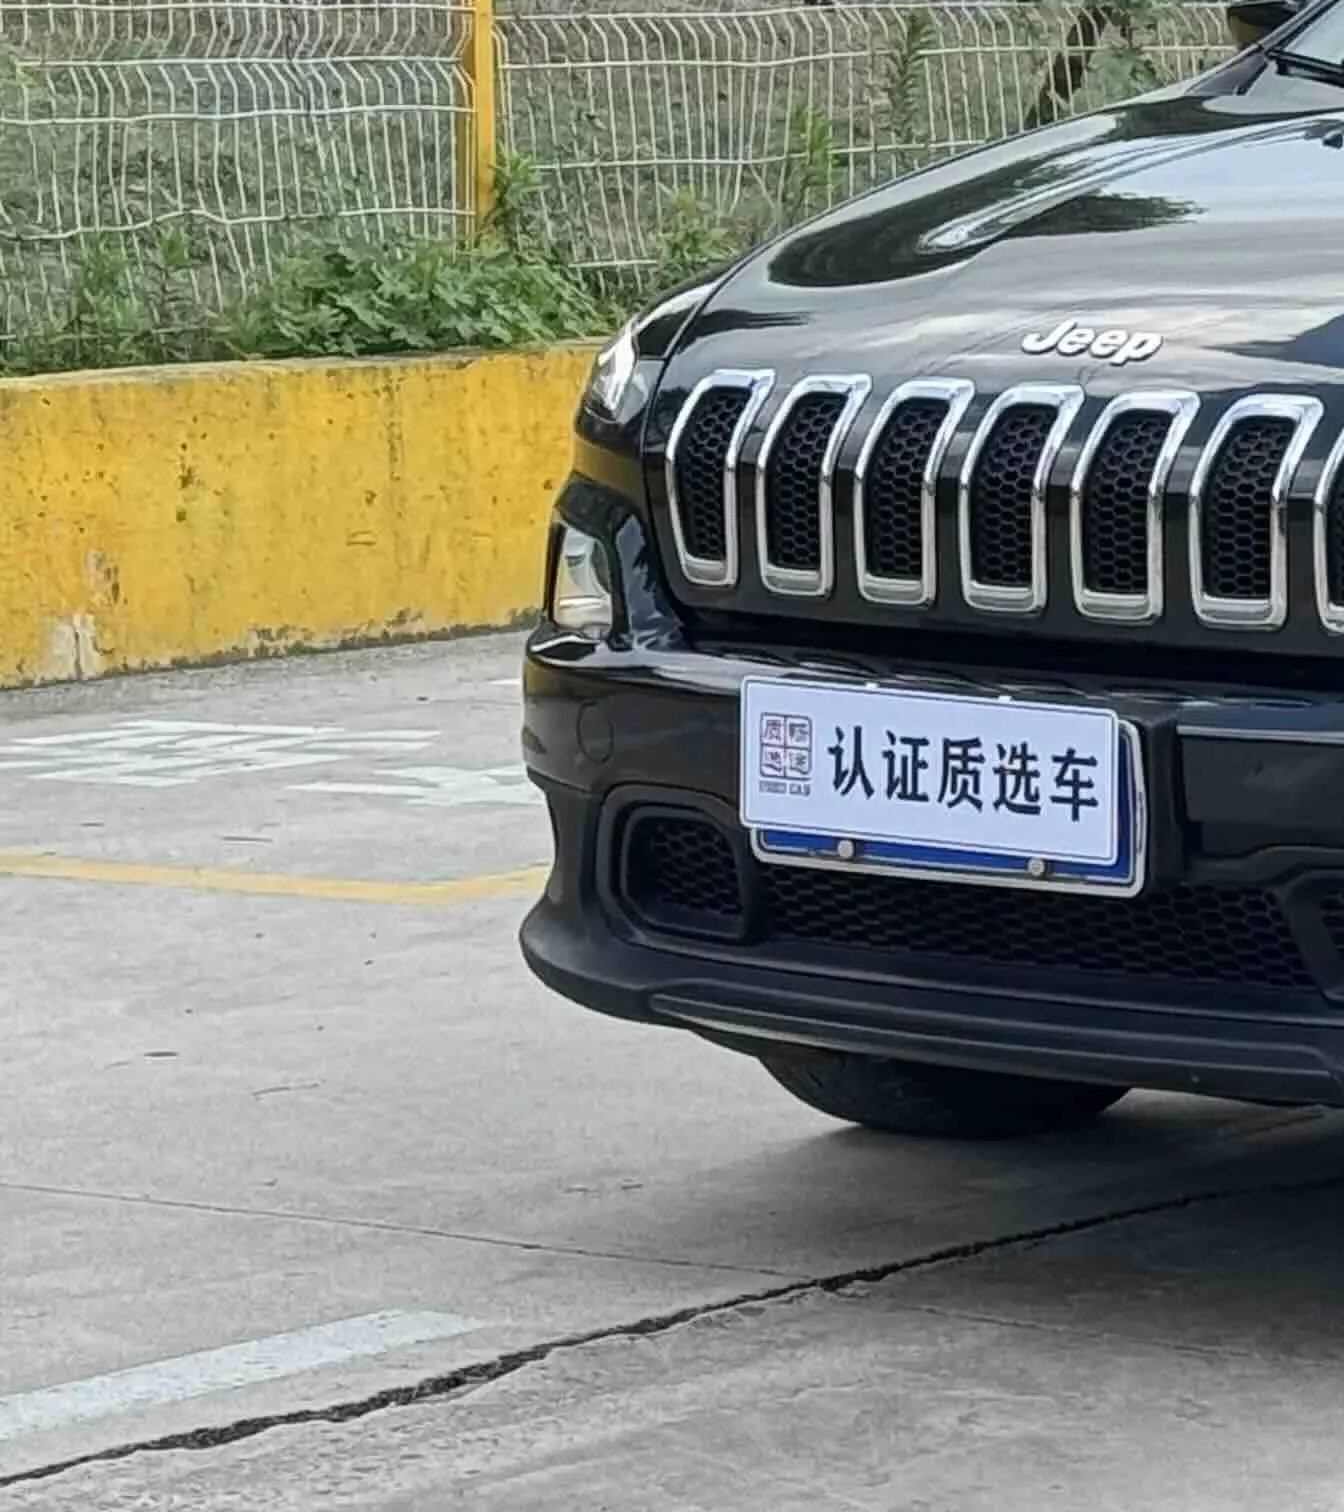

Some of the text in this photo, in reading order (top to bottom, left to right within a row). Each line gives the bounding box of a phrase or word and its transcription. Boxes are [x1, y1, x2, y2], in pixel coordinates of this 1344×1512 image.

[1020, 318, 1164, 367] Jeep
[827, 724, 1100, 822] 认证质选车
